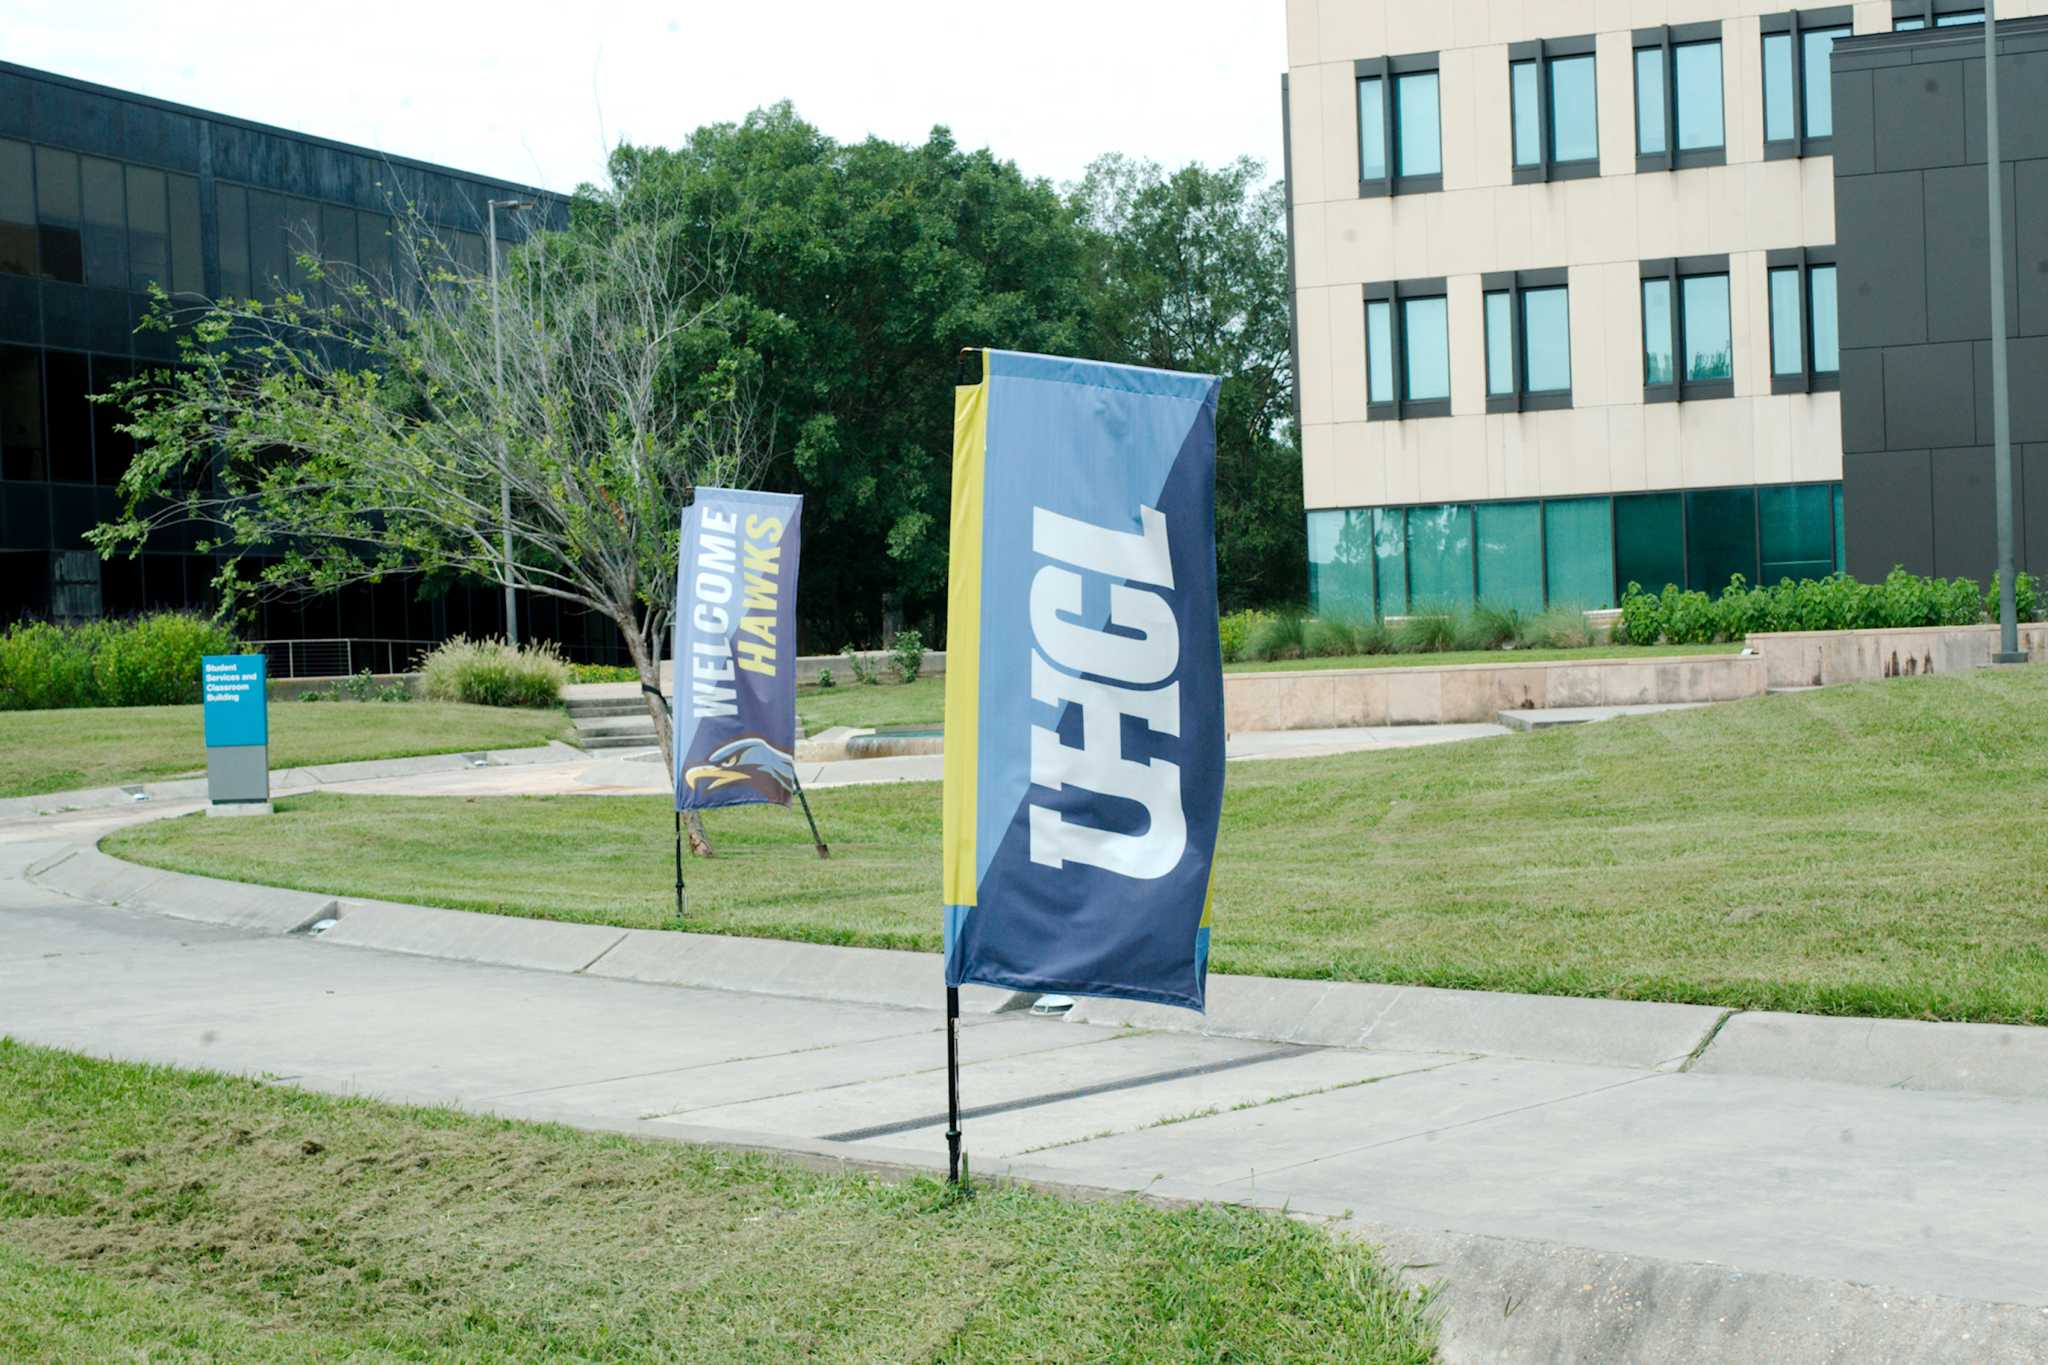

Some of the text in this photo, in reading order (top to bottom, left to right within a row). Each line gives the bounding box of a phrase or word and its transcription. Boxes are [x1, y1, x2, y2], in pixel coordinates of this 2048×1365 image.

[737, 513, 784, 678] HAWKS
[692, 506, 739, 719] WELCOME
[206, 663, 237, 672] Student
[206, 672, 257, 682] Services and
[206, 683, 250, 692] Classroom
[1029, 504, 1187, 880] UHCL
[206, 693, 240, 703] Building
